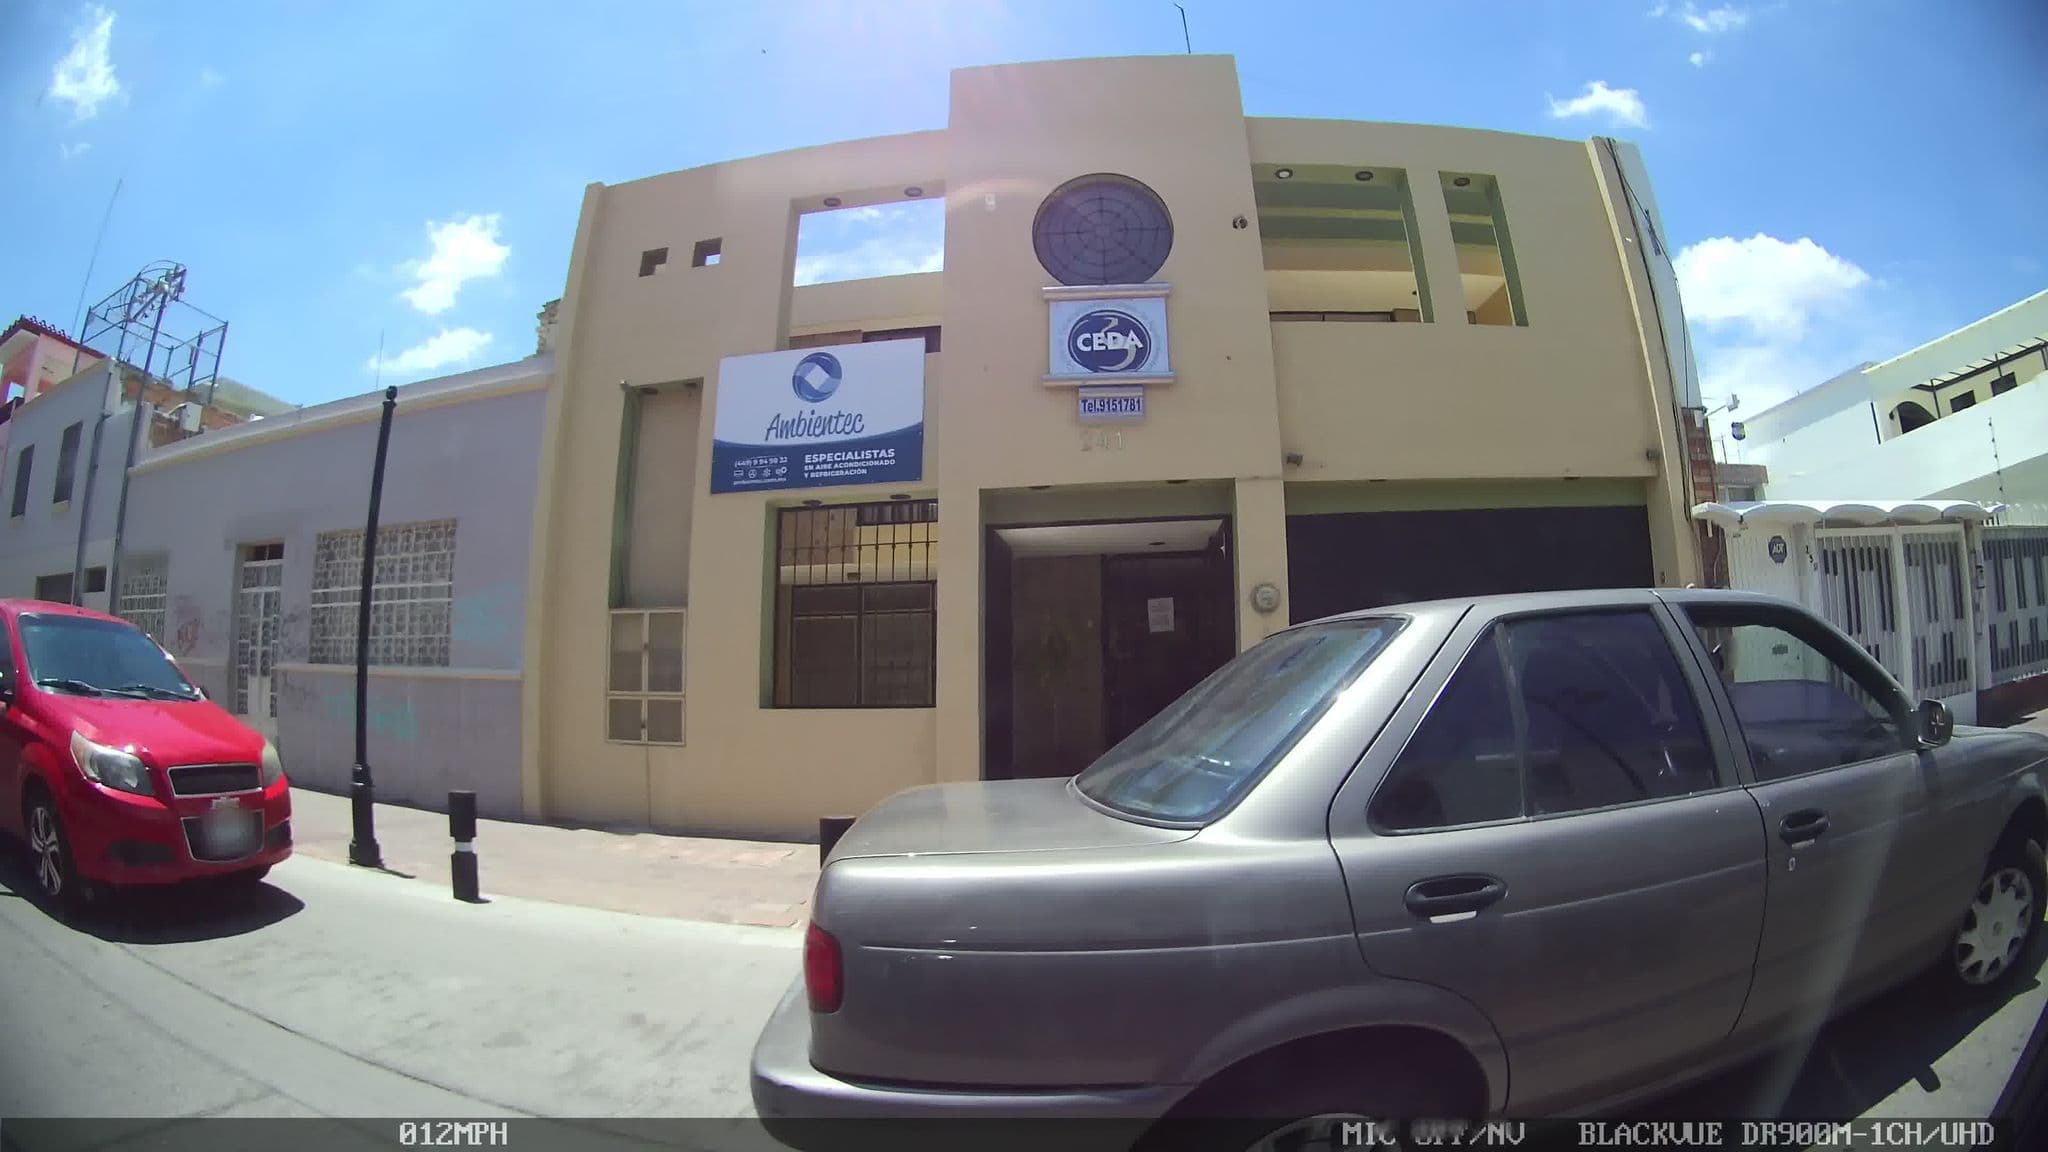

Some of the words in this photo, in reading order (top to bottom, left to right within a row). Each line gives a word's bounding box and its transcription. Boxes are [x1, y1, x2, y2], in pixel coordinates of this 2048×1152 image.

[1076, 329, 1144, 352] CEDA
[1081, 398, 1141, 413] Tel.9151781
[764, 409, 865, 442] Ambientec
[804, 448, 896, 464] ESPECIALISTAS
[815, 463, 832, 471] AIRE
[833, 459, 896, 469] ACONDICIONADO
